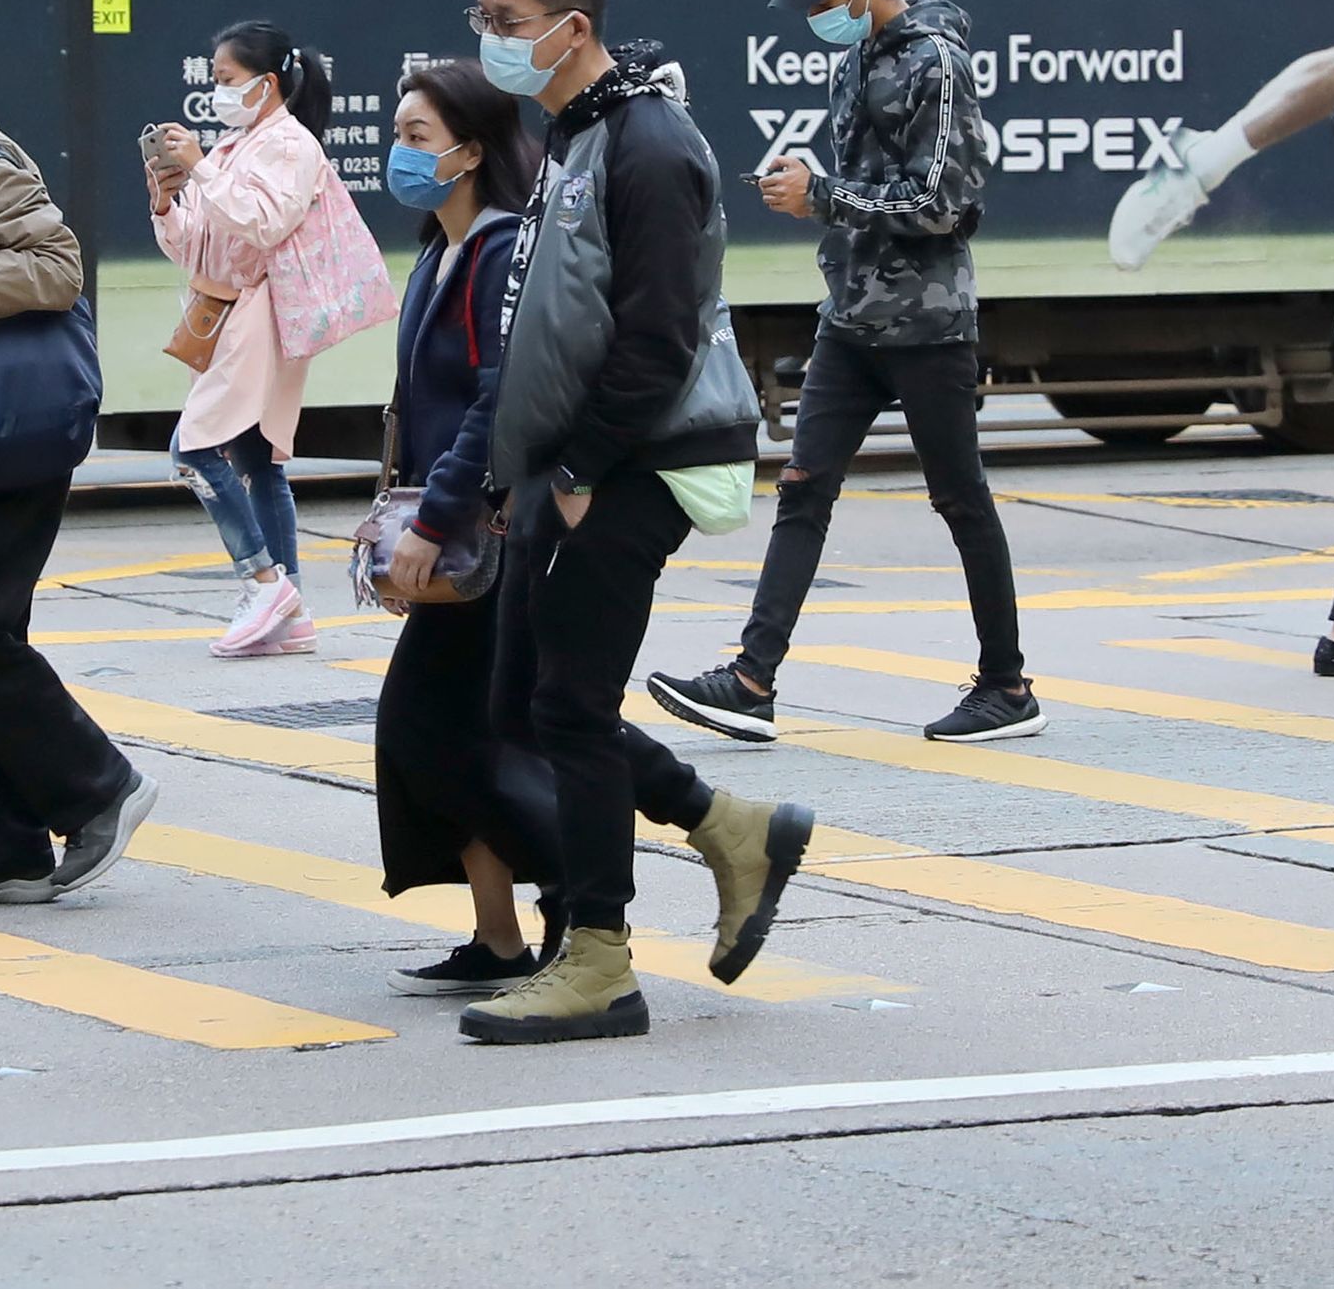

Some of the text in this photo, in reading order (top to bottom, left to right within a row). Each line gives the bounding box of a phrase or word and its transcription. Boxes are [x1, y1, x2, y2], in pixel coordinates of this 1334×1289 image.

[93, 10, 126, 25] EXIT
[746, 29, 1184, 98] Keeg Forward
[343, 157, 381, 173] 0235
